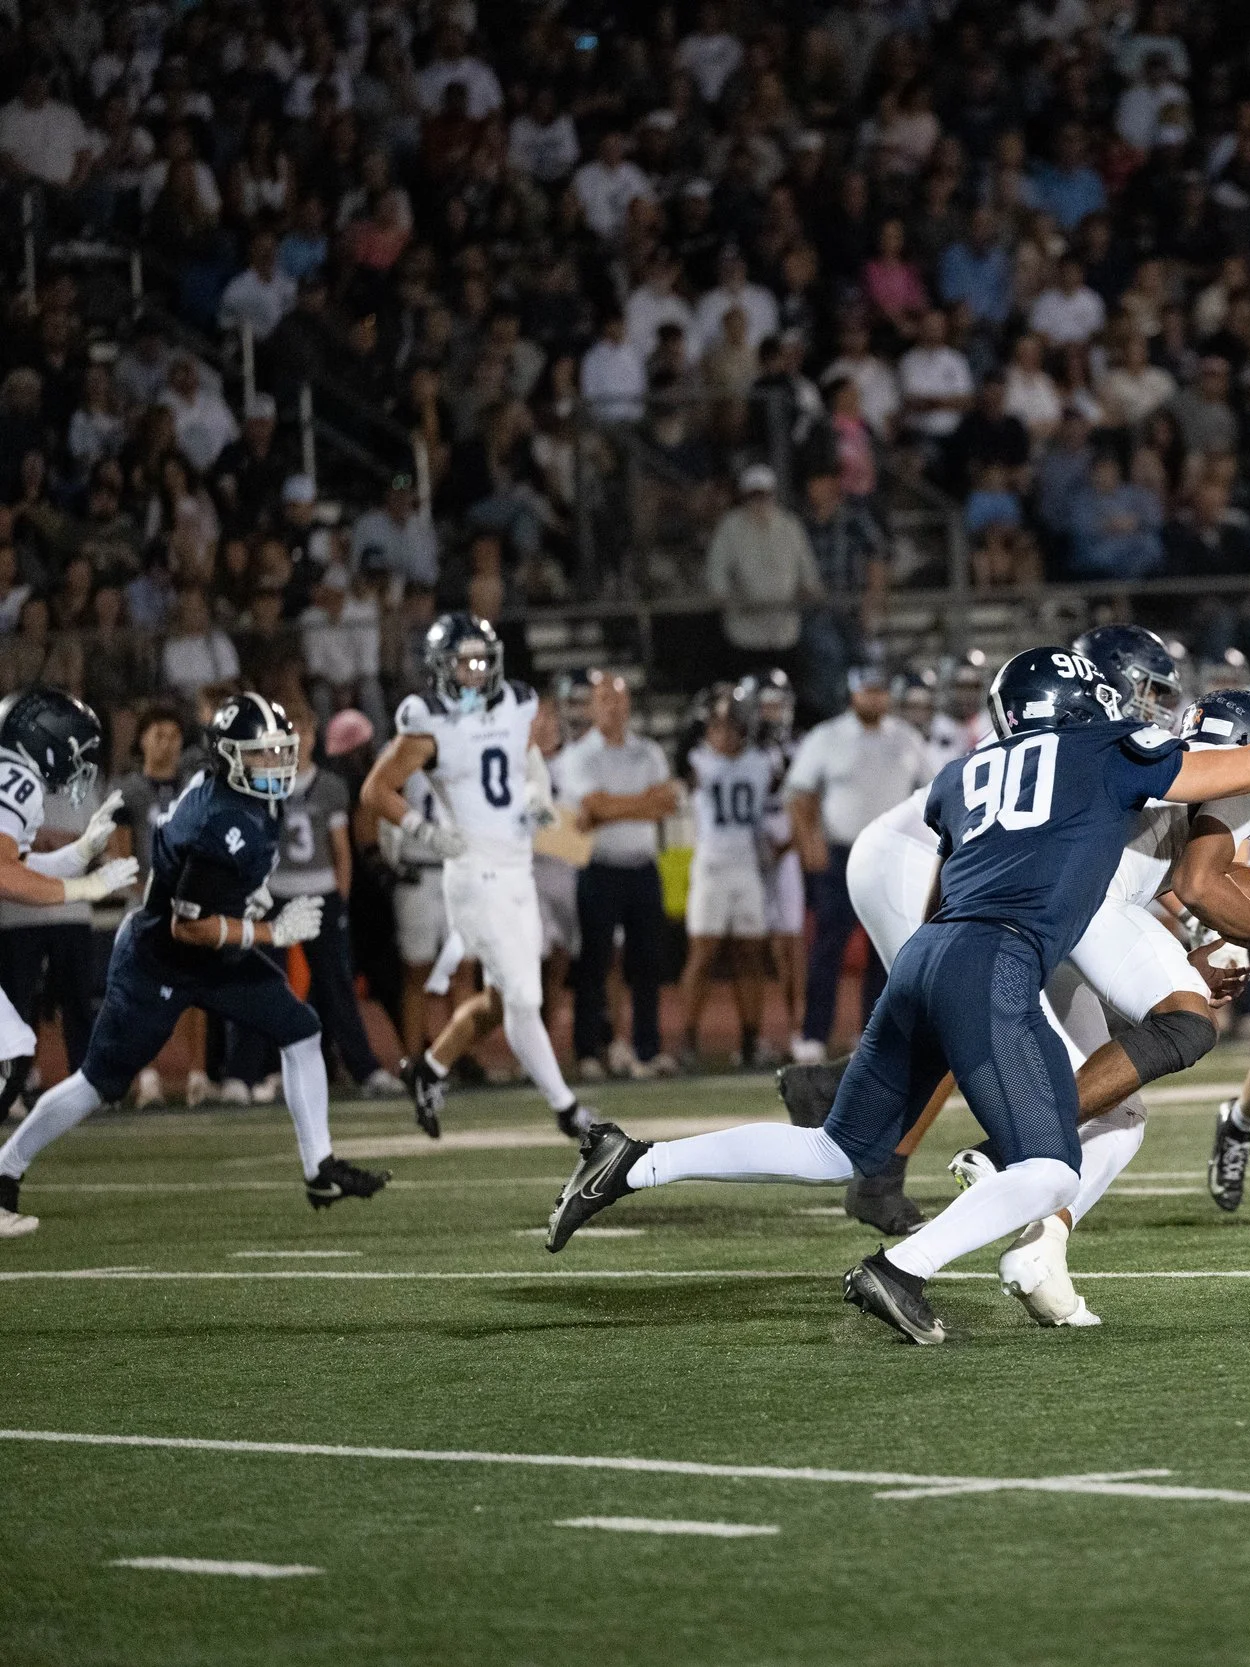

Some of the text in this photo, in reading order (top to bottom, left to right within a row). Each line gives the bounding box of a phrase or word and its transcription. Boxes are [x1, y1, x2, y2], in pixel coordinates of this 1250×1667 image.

[1051, 653, 1094, 682] 90
[0, 767, 36, 805] 78
[481, 747, 512, 807] 0
[962, 732, 1060, 845] 90
[712, 782, 755, 825] 10
